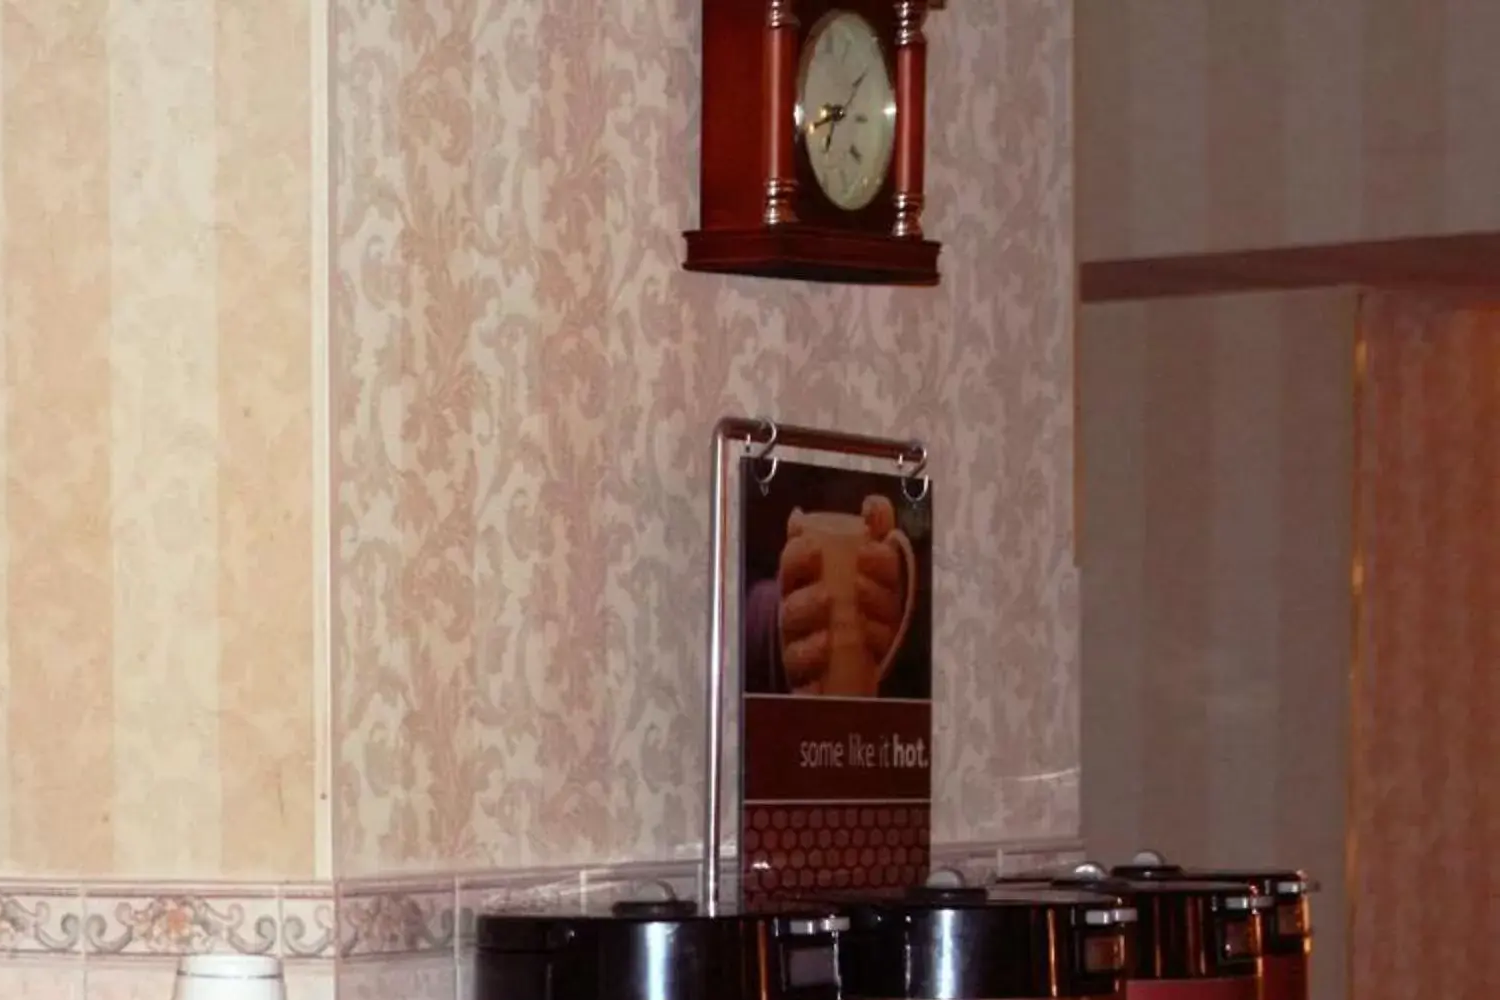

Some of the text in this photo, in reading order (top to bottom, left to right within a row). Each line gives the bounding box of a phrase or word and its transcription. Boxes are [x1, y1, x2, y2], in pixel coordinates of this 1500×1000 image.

[800, 732, 929, 768] some like it hot.
